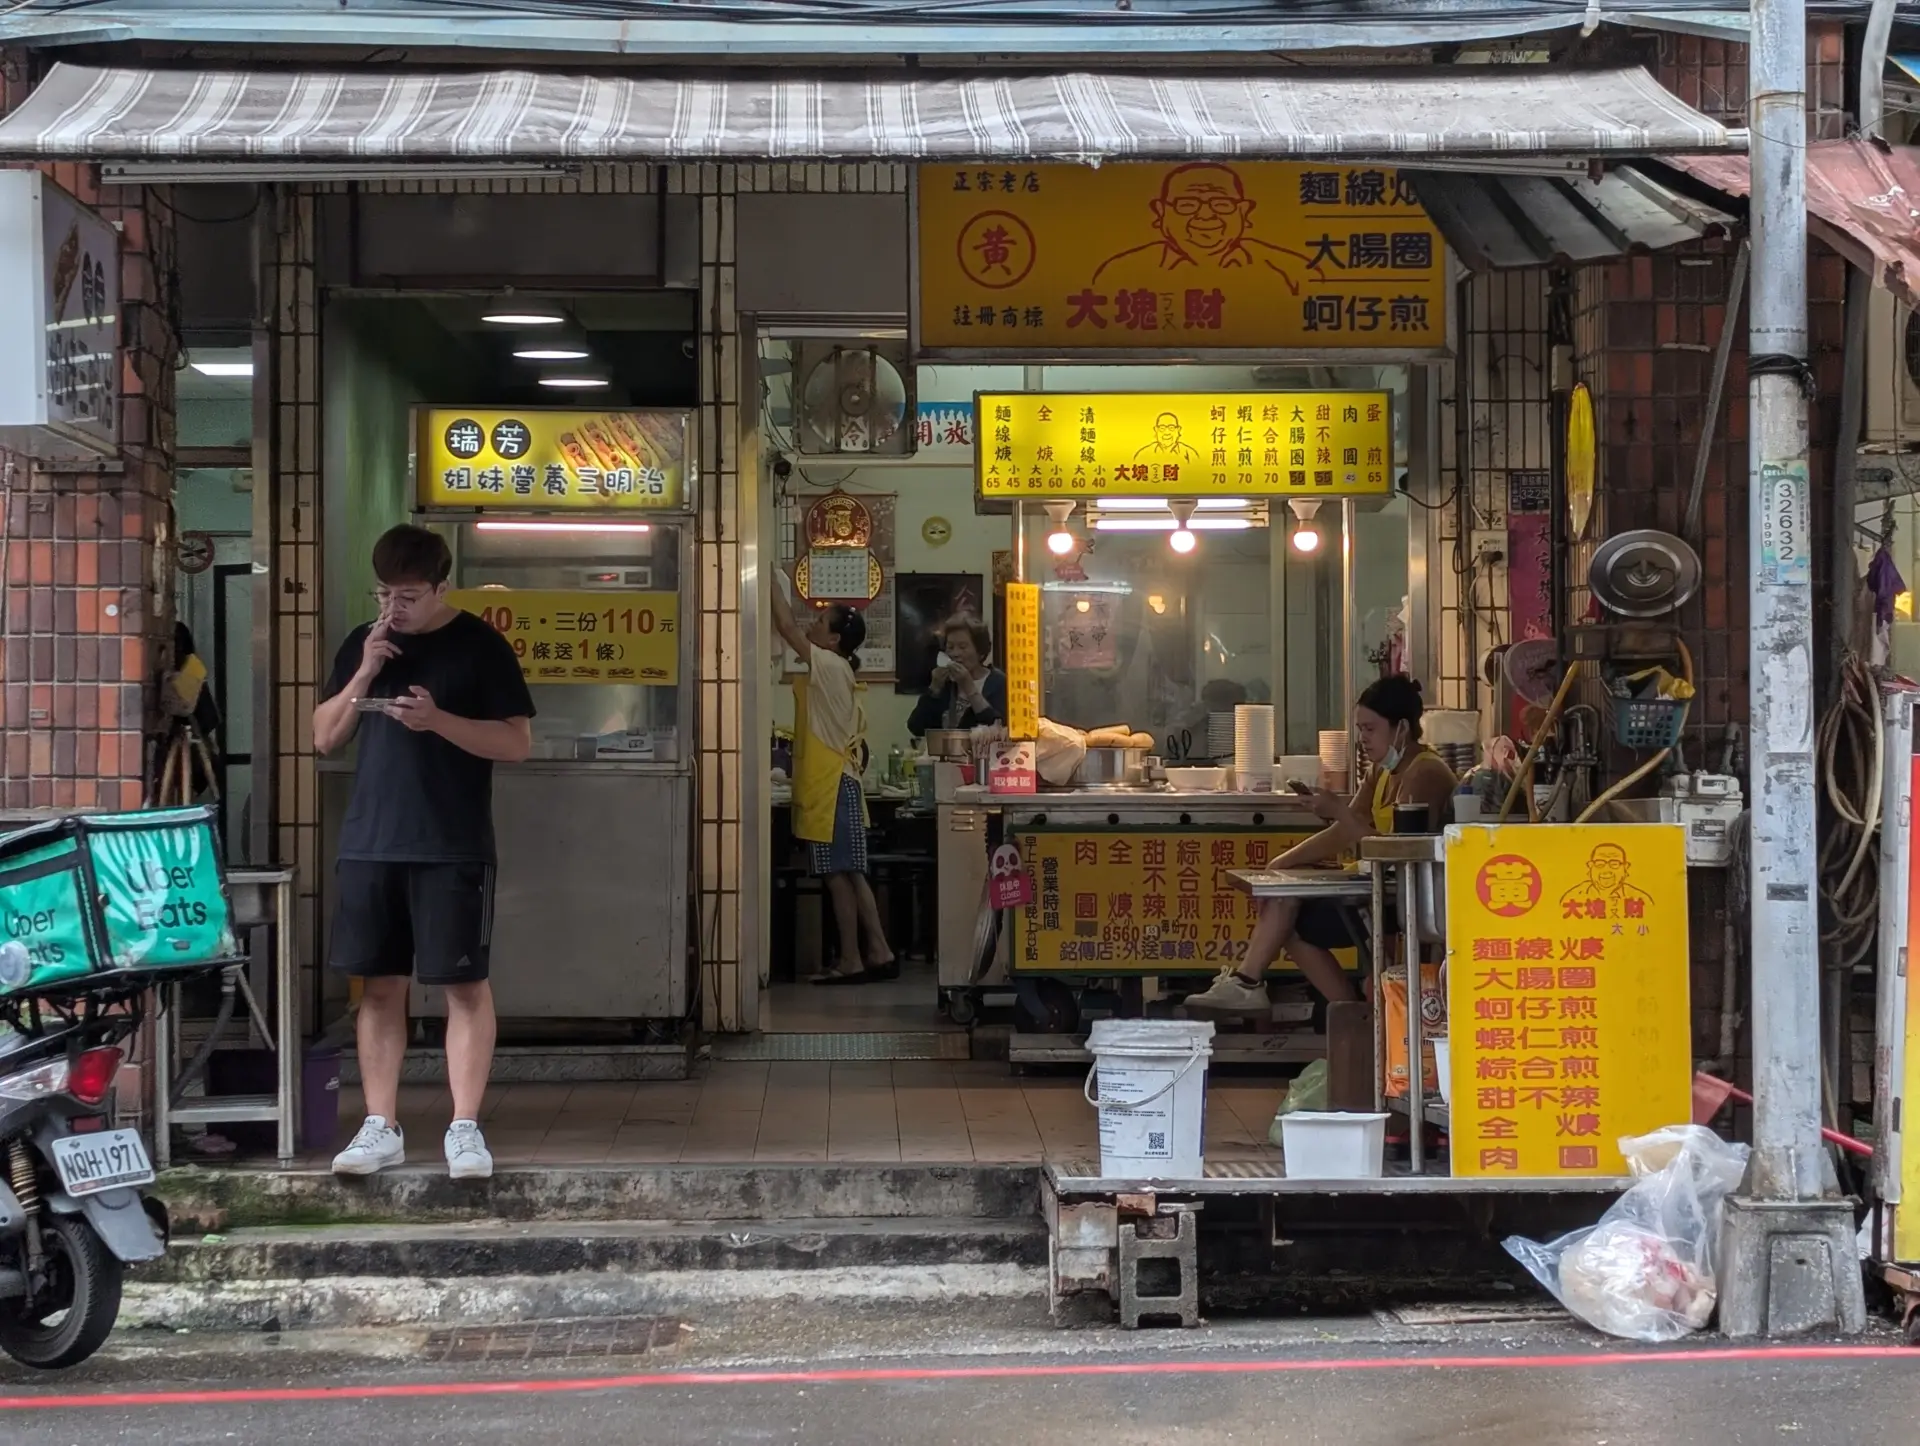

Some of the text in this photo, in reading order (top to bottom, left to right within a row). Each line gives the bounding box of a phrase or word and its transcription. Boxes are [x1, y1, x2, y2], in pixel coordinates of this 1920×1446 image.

[953, 171, 1040, 193] 正宗老店
[1305, 232, 1432, 269] 大腸圈
[953, 305, 1044, 328] 註冊商標
[1302, 295, 1430, 332] 蚵仔煎
[1080, 406, 1096, 463] 清麵線
[1210, 405, 1226, 466] 蚵仔煎
[1237, 405, 1253, 467] 蝦仁煎
[1262, 405, 1278, 467] 綜合煎
[1289, 405, 1305, 466] 大腸圈
[1316, 404, 1331, 464] 甜不辣
[444, 464, 666, 496] 姐妹營養三明治
[986, 477, 1000, 488] 65
[1006, 477, 1020, 488] 45
[1028, 477, 1042, 488] 85
[1048, 477, 1062, 488] 60
[1071, 477, 1086, 488] 60
[1092, 477, 1106, 488] 40
[1212, 473, 1226, 484] 70
[1238, 473, 1252, 484] 70
[1264, 473, 1278, 484] 70
[1368, 472, 1382, 483] 65
[1780, 484, 1793, 560] 32632
[126, 861, 195, 893] Uber
[1042, 857, 1059, 930] 營業時間
[1142, 840, 1166, 919] 甜不辣
[1176, 840, 1200, 919] 綜合煎
[4, 908, 56, 938] Uber
[135, 897, 207, 931] Eats
[1611, 923, 1649, 936] 大 小
[1213, 924, 1231, 940] 70
[28, 941, 65, 968] ats
[1473, 966, 1596, 990] 大腸圈
[1474, 996, 1598, 1020] 蚵仔煎
[1475, 1025, 1599, 1050] 蝦仁煎
[1476, 1055, 1599, 1080] 綜合煎
[1477, 1085, 1601, 1110] 甜不辣
[61, 1142, 144, 1182] NQH-1971
